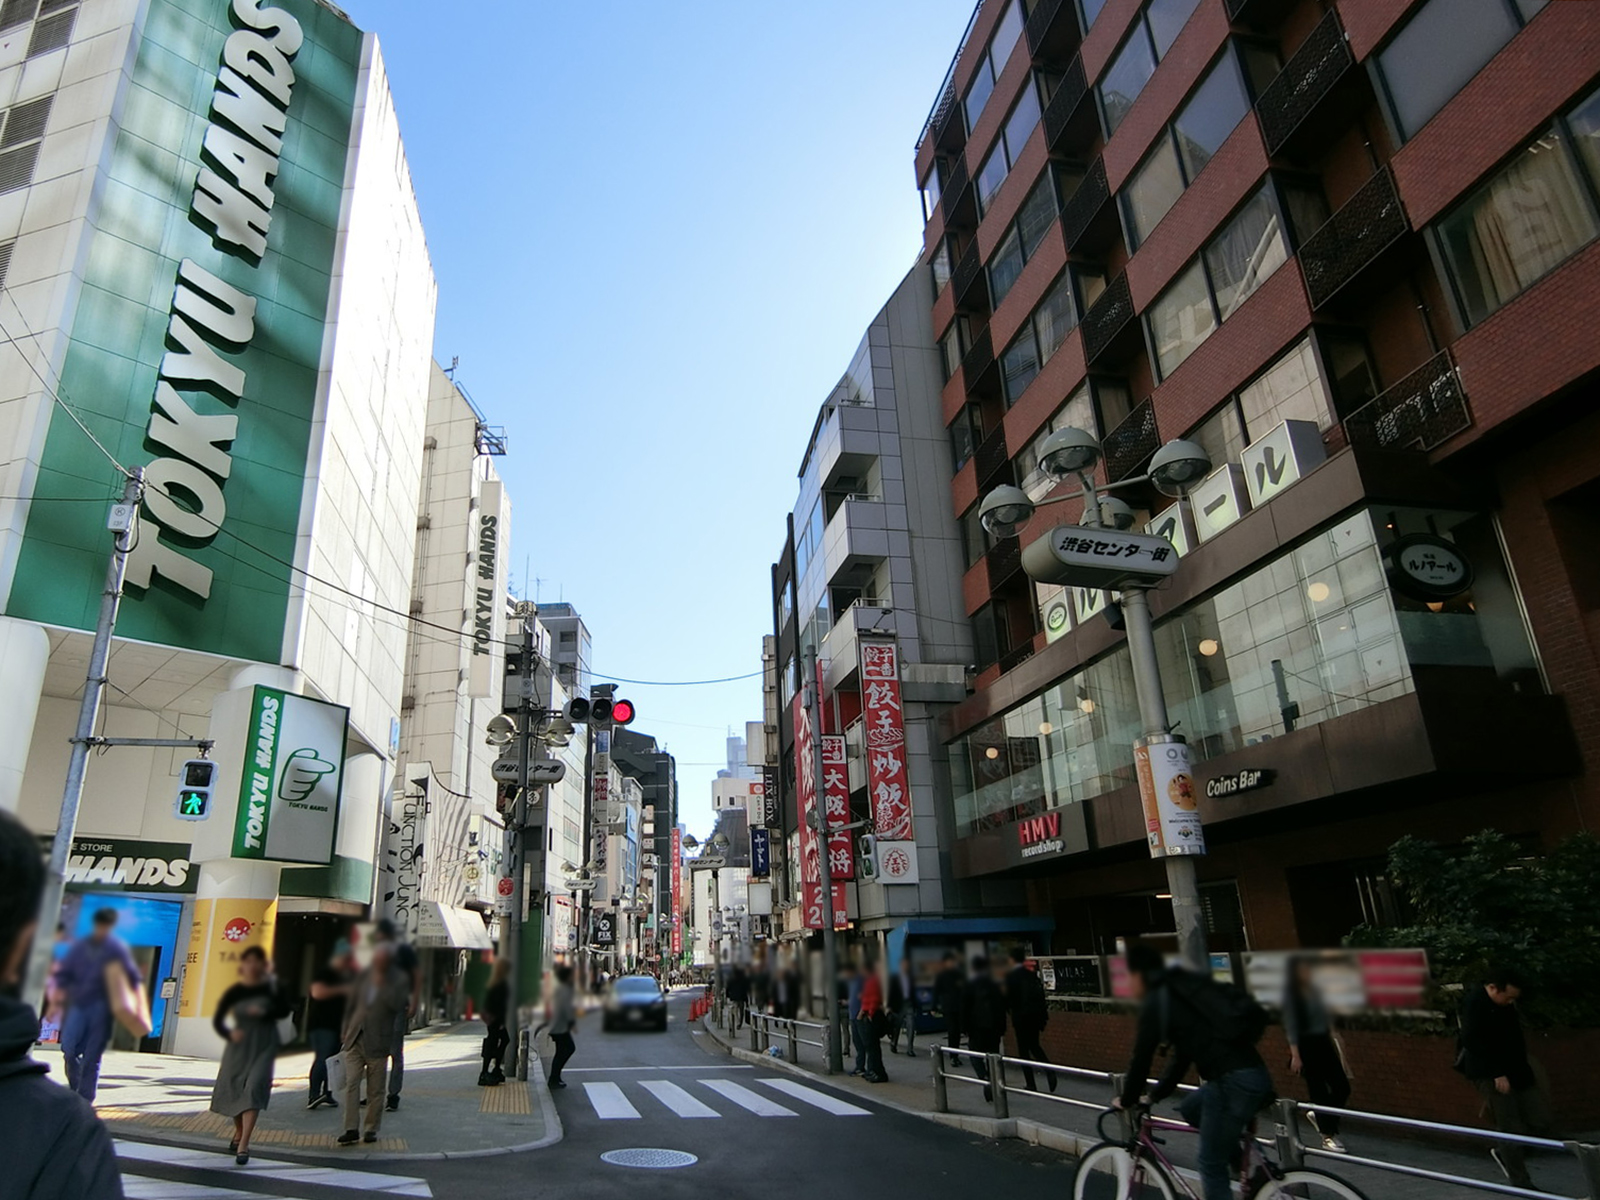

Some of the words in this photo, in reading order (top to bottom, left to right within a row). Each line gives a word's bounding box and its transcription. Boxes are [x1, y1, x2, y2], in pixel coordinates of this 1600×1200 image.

[189, 0, 304, 267] HANDS
[125, 258, 257, 600] TOKYU
[478, 515, 497, 580] HANDS
[1059, 536, 1170, 562] 渋谷センター街
[1409, 559, 1457, 573] ルノアール
[473, 587, 493, 656] TOKYU
[255, 696, 279, 769] HANDS
[865, 681, 900, 734] 餃子
[766, 798, 774, 821] BOX
[873, 752, 907, 810] 炒飯
[1207, 776, 1238, 797] Coins
[1239, 770, 1261, 789] Bar
[244, 772, 269, 849] TOKYU
[398, 795, 424, 875] FUNCTION
[824, 768, 851, 873] 大阪王将
[1018, 812, 1060, 846] HMV
[66, 855, 190, 887] HANDS
[80, 843, 113, 853] STORE
